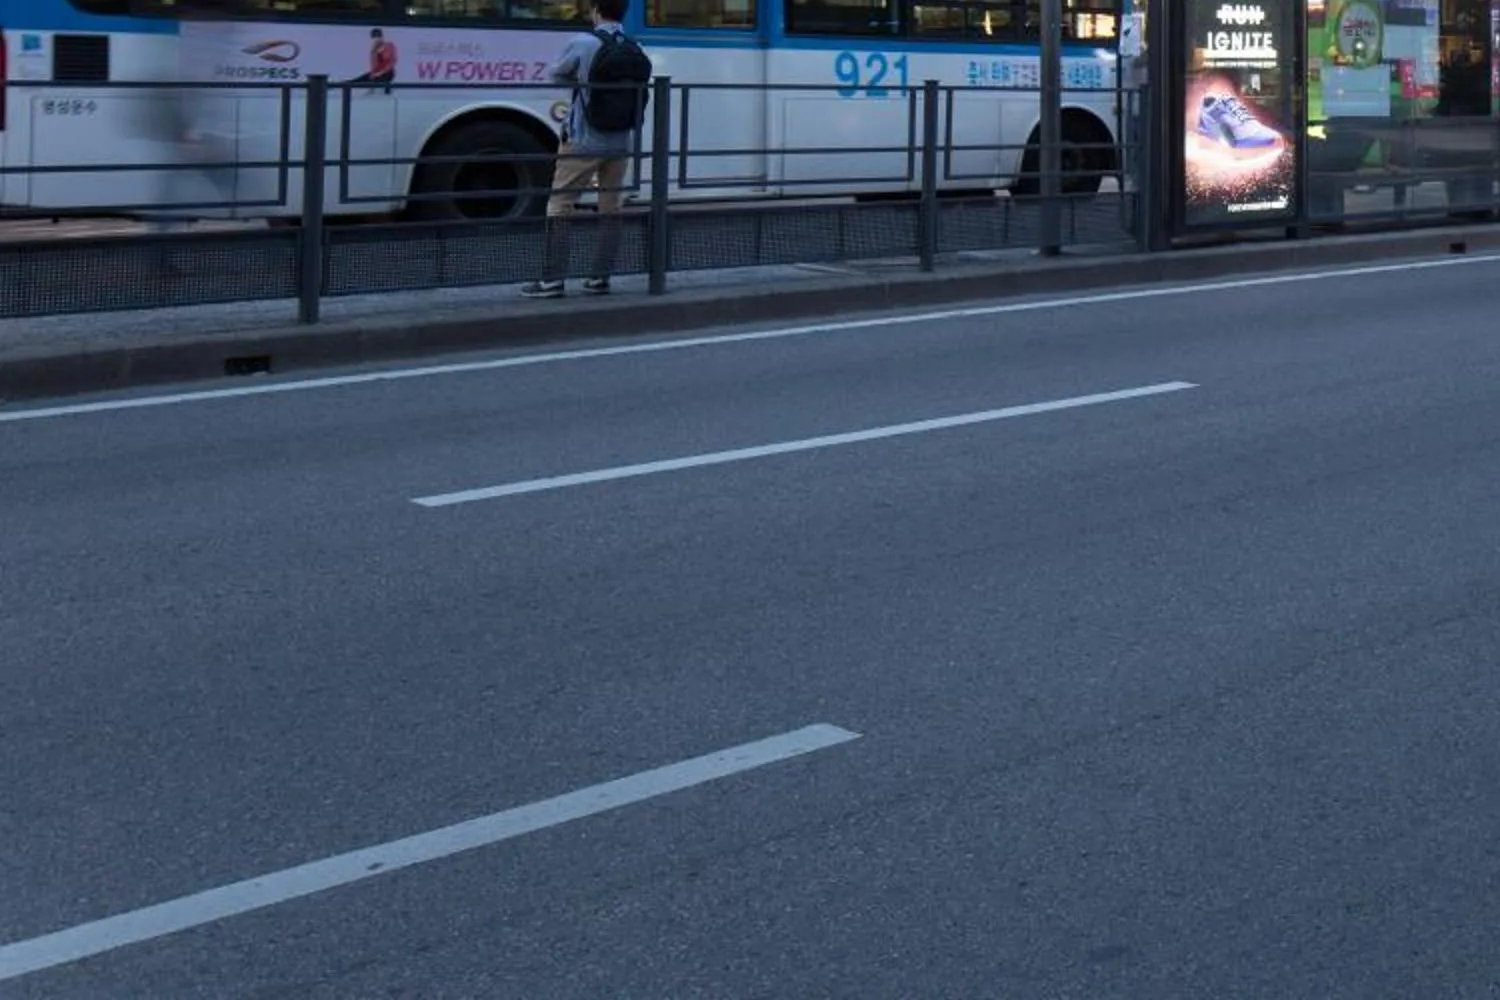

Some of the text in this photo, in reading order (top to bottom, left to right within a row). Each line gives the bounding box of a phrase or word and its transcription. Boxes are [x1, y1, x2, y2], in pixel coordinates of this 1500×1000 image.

[1207, 31, 1273, 50] IGNITE
[214, 66, 300, 79] PROSPECS
[417, 60, 442, 79] W
[444, 61, 526, 81] POWER
[835, 50, 909, 99] 921
